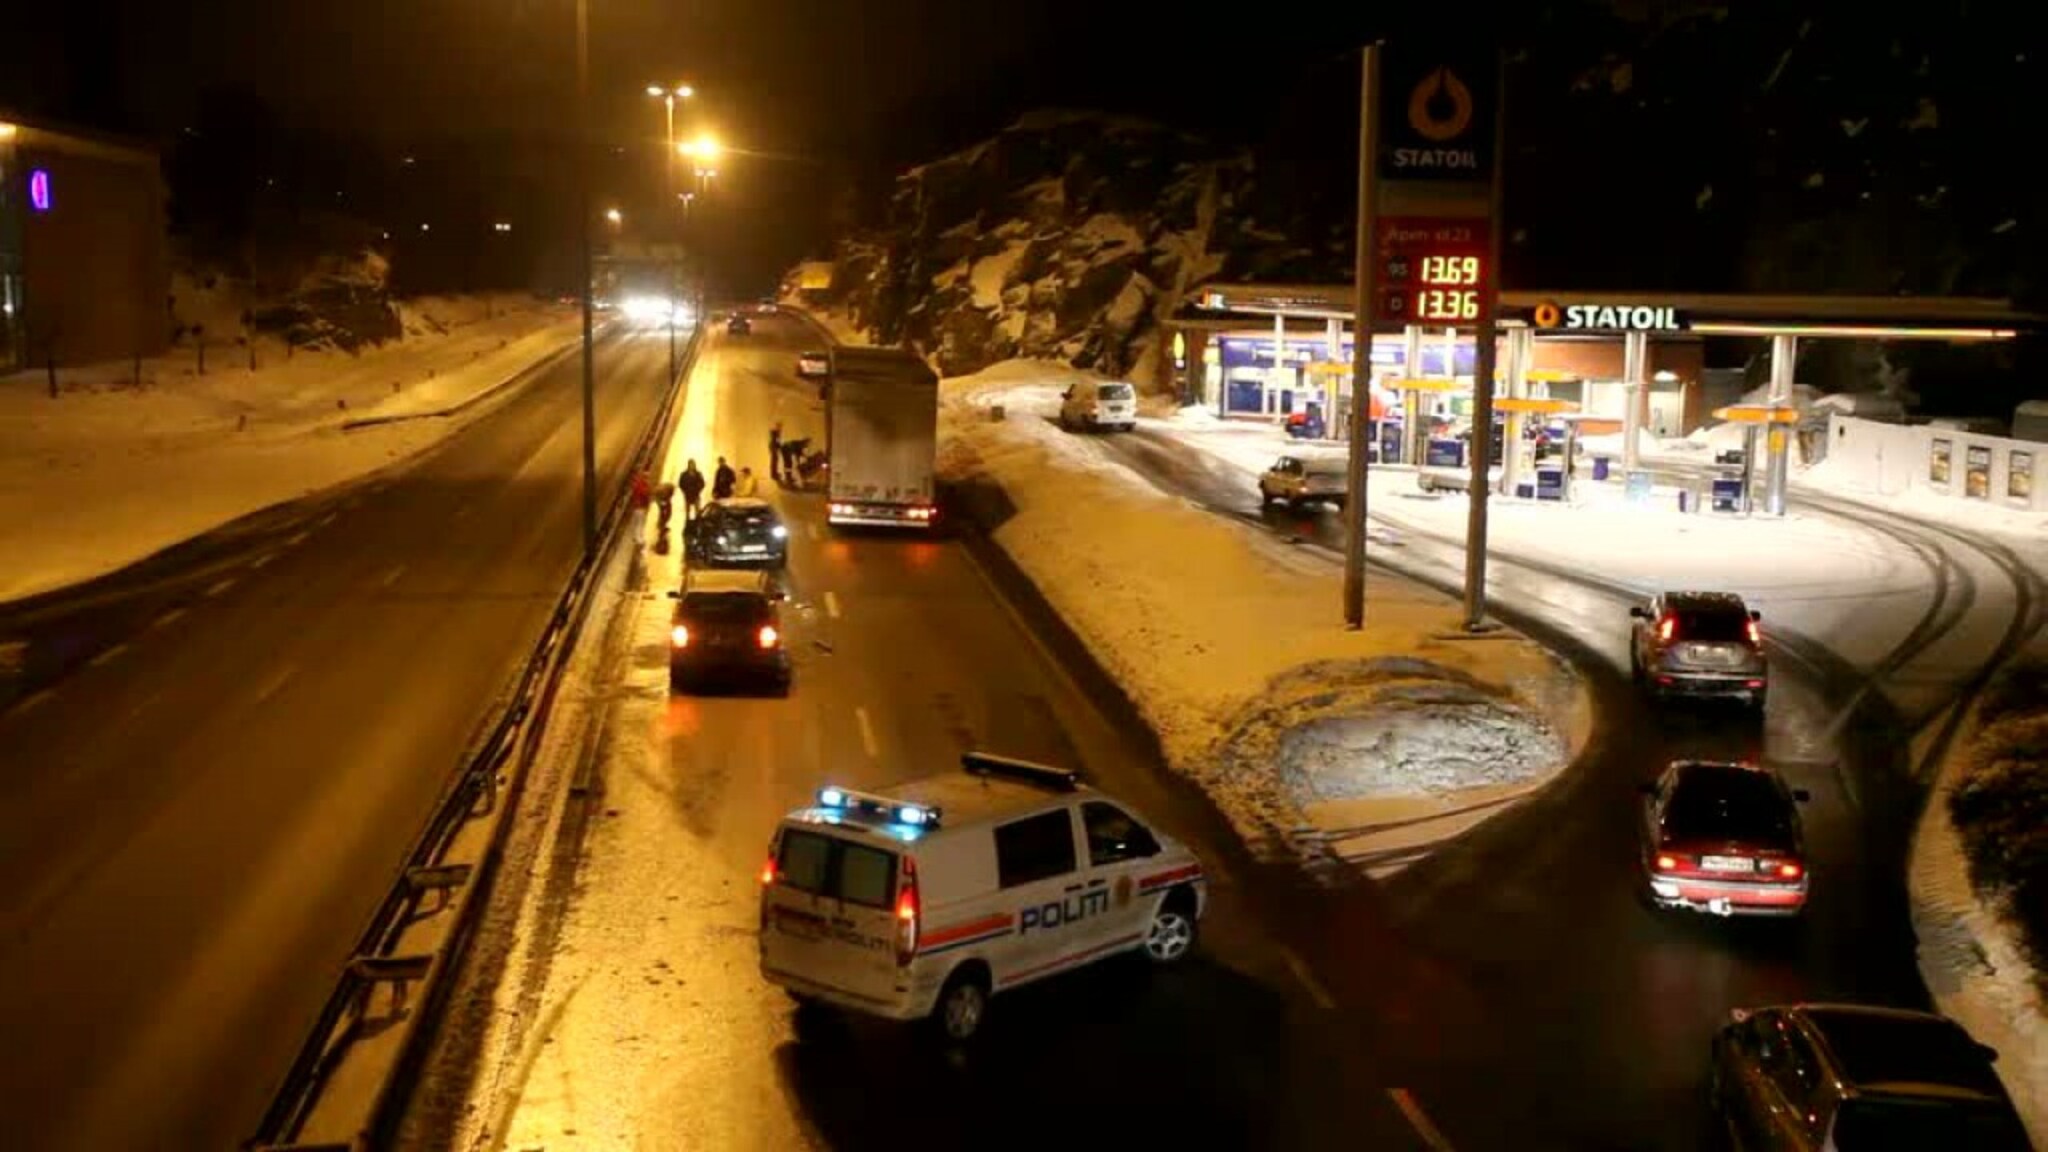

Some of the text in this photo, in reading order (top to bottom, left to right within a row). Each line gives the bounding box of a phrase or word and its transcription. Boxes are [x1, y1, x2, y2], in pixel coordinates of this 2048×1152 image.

[1393, 148, 1477, 169] STATOIL
[1566, 304, 1680, 330] STATOIL
[1019, 887, 1110, 935] POLITI
